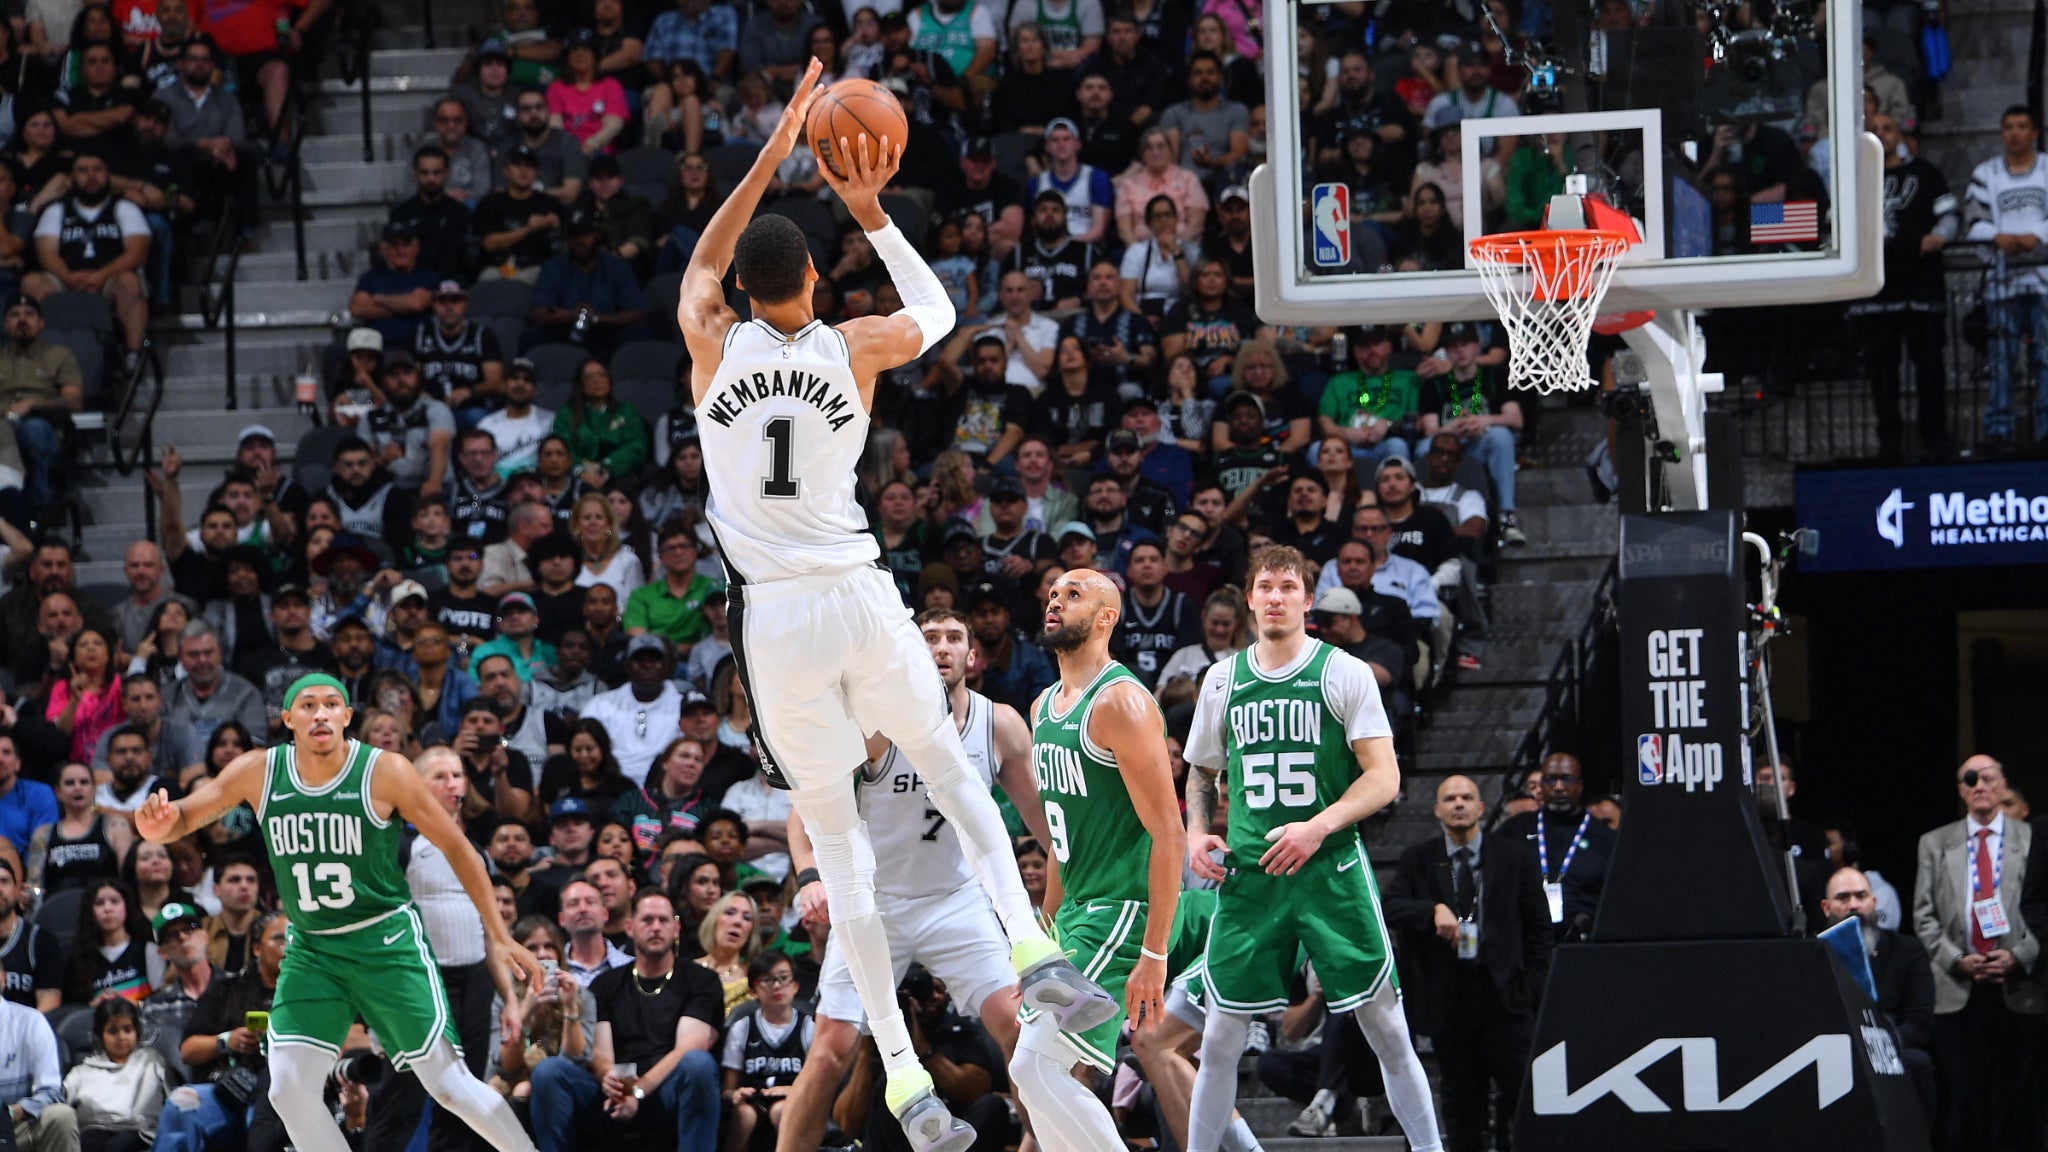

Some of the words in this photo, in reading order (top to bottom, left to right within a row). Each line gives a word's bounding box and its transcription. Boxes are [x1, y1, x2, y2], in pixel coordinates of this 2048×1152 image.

[1319, 247, 1337, 261] NBA
[707, 370, 855, 433] WEMBANYAMA
[760, 415, 801, 499] 1
[1929, 488, 2048, 527] Metho
[1930, 525, 2048, 545] HEALTHCA
[1137, 651, 1157, 672] 5
[1648, 629, 1703, 678] GET
[1293, 680, 1320, 688] Amica
[1648, 680, 1708, 729] THE
[1230, 698, 1321, 749] BOSTON
[1032, 742, 1088, 797] OSTON
[1241, 752, 1317, 809] 55
[1666, 734, 1724, 793] App
[268, 812, 363, 856] BOSTON
[922, 809, 947, 841] 7
[1045, 800, 1071, 864] 9
[291, 862, 356, 912] 13
[745, 1056, 802, 1075] SPURS
[1531, 1033, 1854, 1116] KIA
